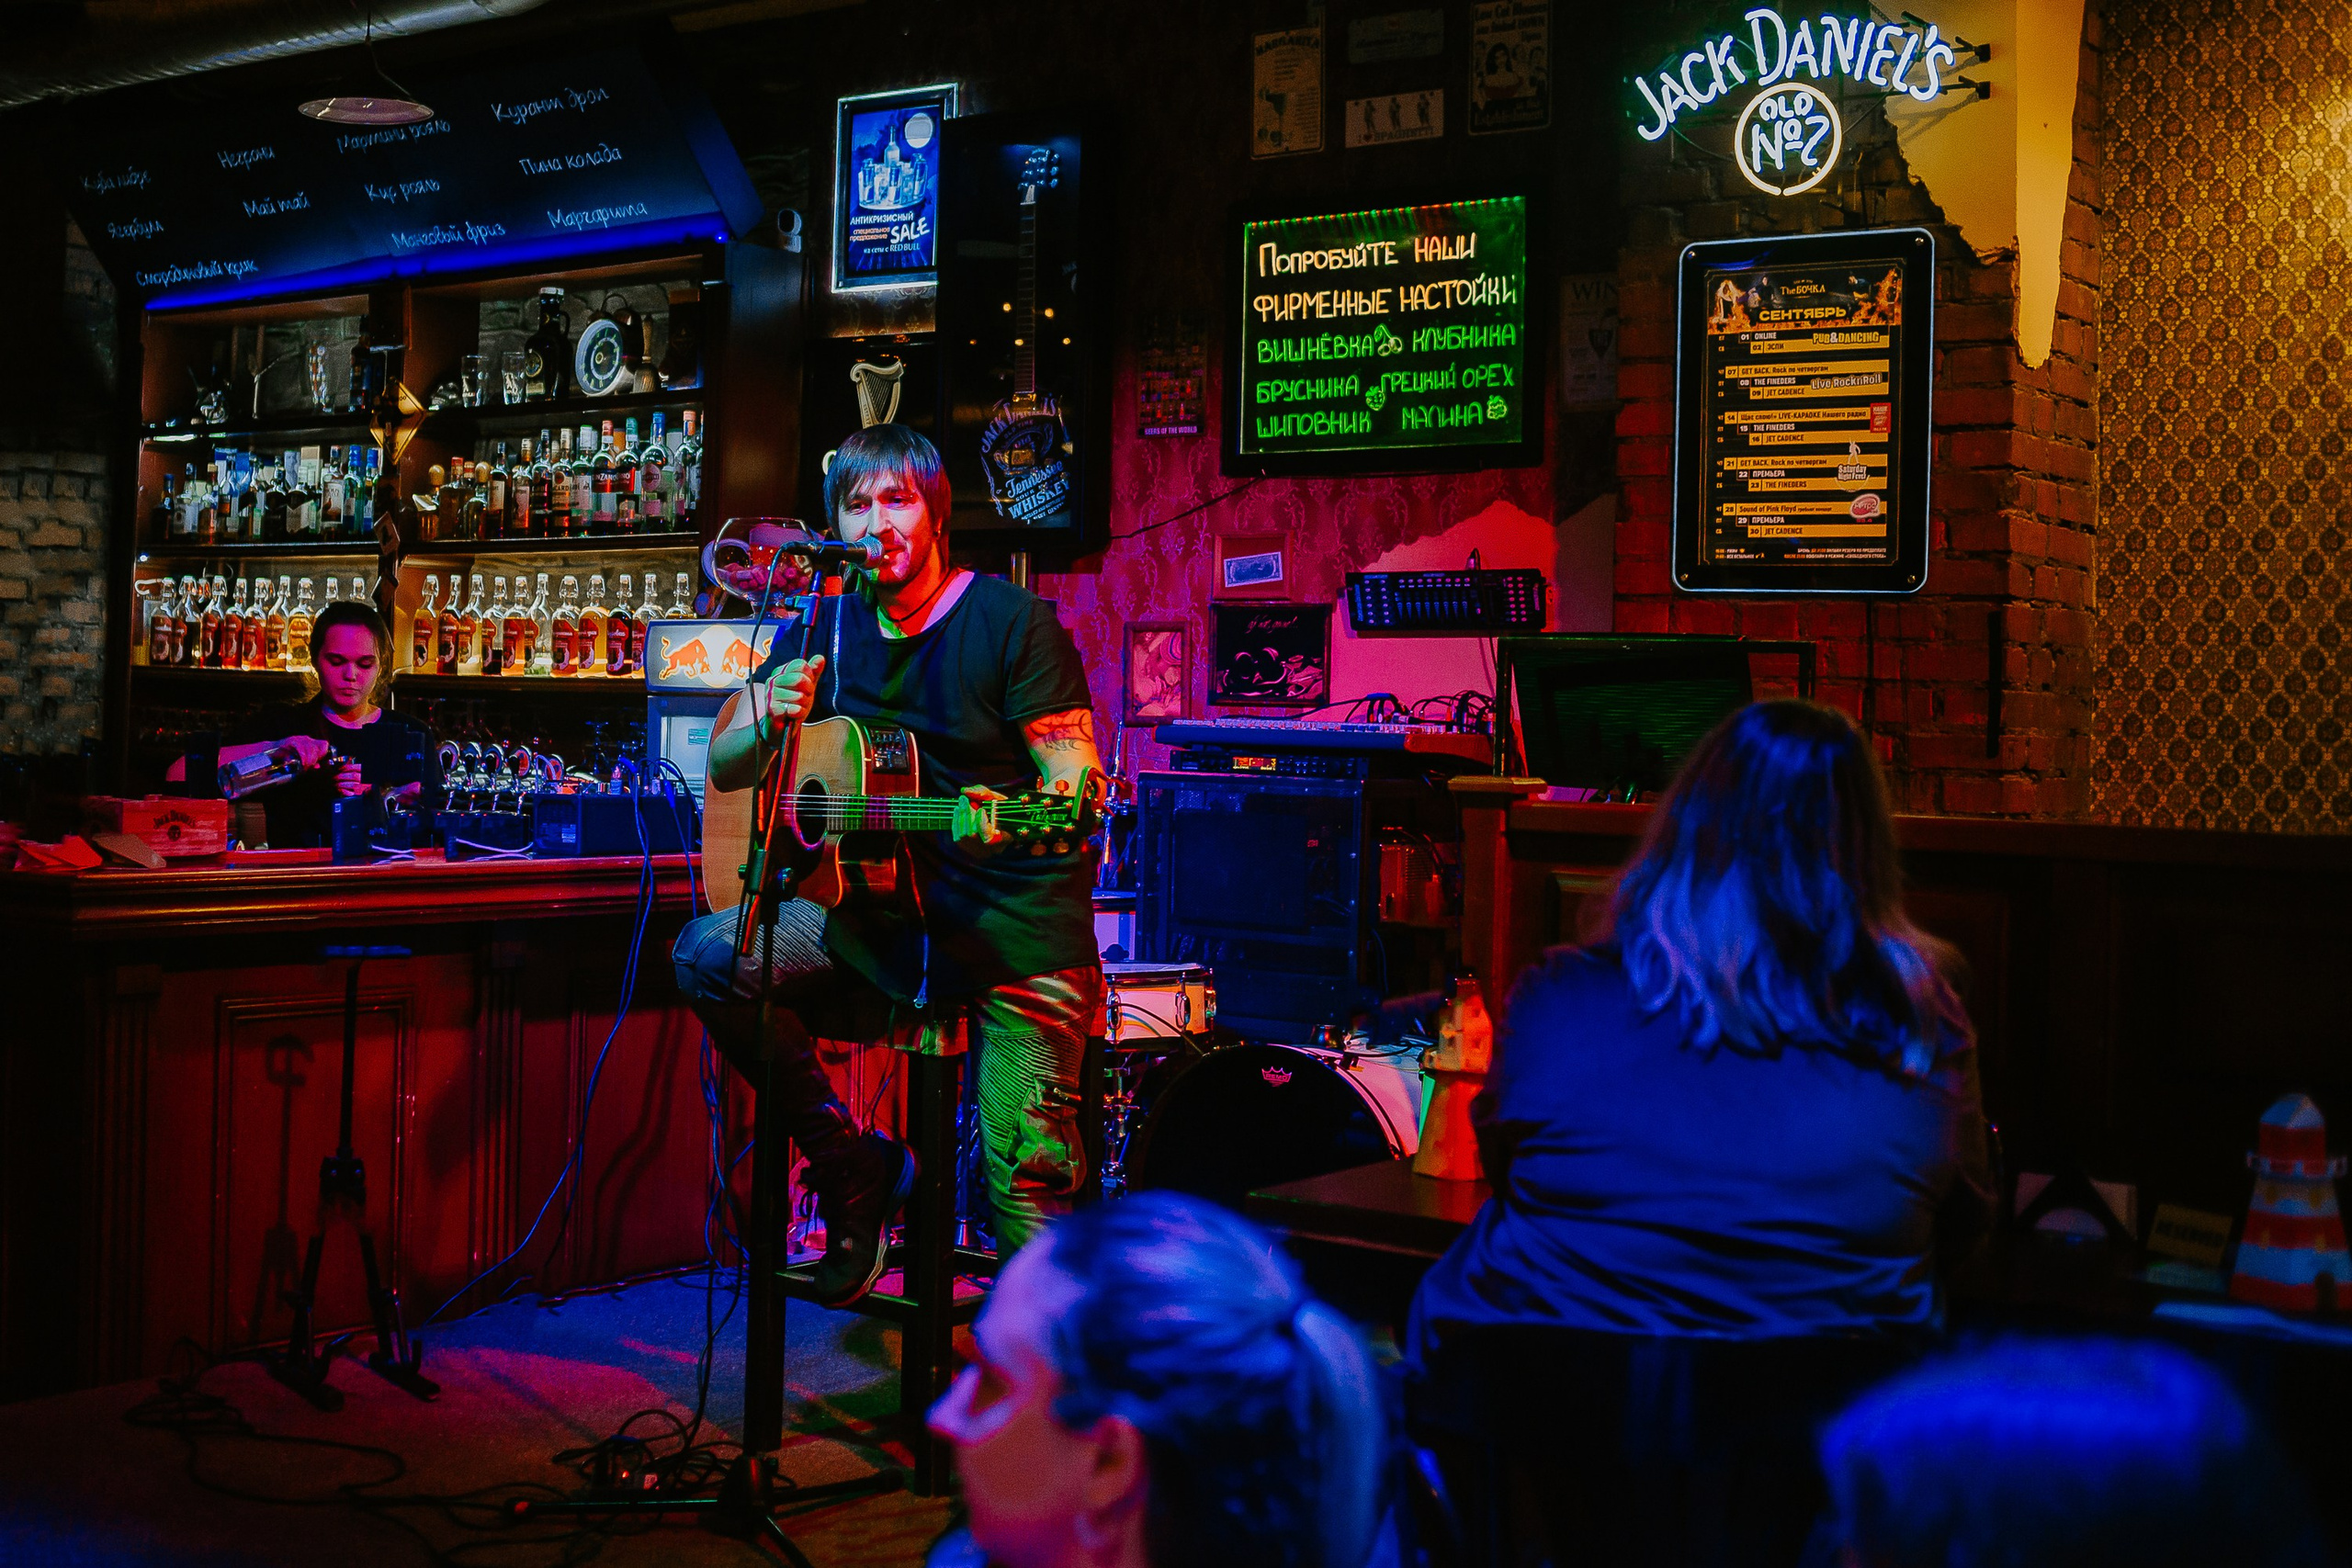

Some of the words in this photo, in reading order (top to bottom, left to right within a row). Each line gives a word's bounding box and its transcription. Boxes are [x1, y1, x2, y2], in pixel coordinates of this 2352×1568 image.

[1255, 36, 1320, 56] MARGARITA
[1634, 35, 1746, 141] JACK
[1745, 8, 1955, 101] DANIEL'S
[1759, 92, 1814, 120] OLD
[1374, 126, 1434, 141] SPAGHETTI
[217, 145, 276, 171] Негрони
[518, 158, 562, 175] Пина
[565, 142, 624, 169] колада
[243, 197, 276, 219] Май
[547, 201, 649, 231] Маргарита
[850, 210, 914, 225] АНТИКРИЗИСНЫЙ
[890, 217, 930, 244] SALE
[1415, 231, 1477, 264] НАШИ
[1253, 288, 1393, 322] ФИРМЕННЫЕ
[1399, 273, 1517, 311] НАСТОЙКИ
[1758, 306, 1848, 321] СЕНТЯБРЬ
[1257, 332, 1374, 364] ВИШНЁВКА
[1412, 322, 1517, 353] КЛУБНИКА
[1256, 374, 1361, 404] БРУСНИКА
[1380, 362, 1457, 394] ГРЕЦКИЙ
[1462, 363, 1516, 390] ОРЕХ
[1754, 378, 1765, 386] THE
[1811, 378, 1831, 389] Live
[1256, 411, 1373, 439] ШИПОВНИК
[1401, 400, 1484, 431] МАЛИНА
[1822, 410, 1846, 418] Нашего
[981, 412, 1009, 453] JACK
[1777, 434, 1804, 442] CADENCE
[1005, 460, 1063, 499] Tennessee
[1752, 469, 1785, 478] ПРЕМЬЕРА
[1838, 464, 1867, 474] Saturday
[1008, 479, 1070, 521] WHISKEY
[1739, 505, 1757, 513] Sound
[1766, 504, 1781, 513] Pink
[1781, 504, 1797, 513] Floyd
[1265, 1073, 1288, 1082] REMO
